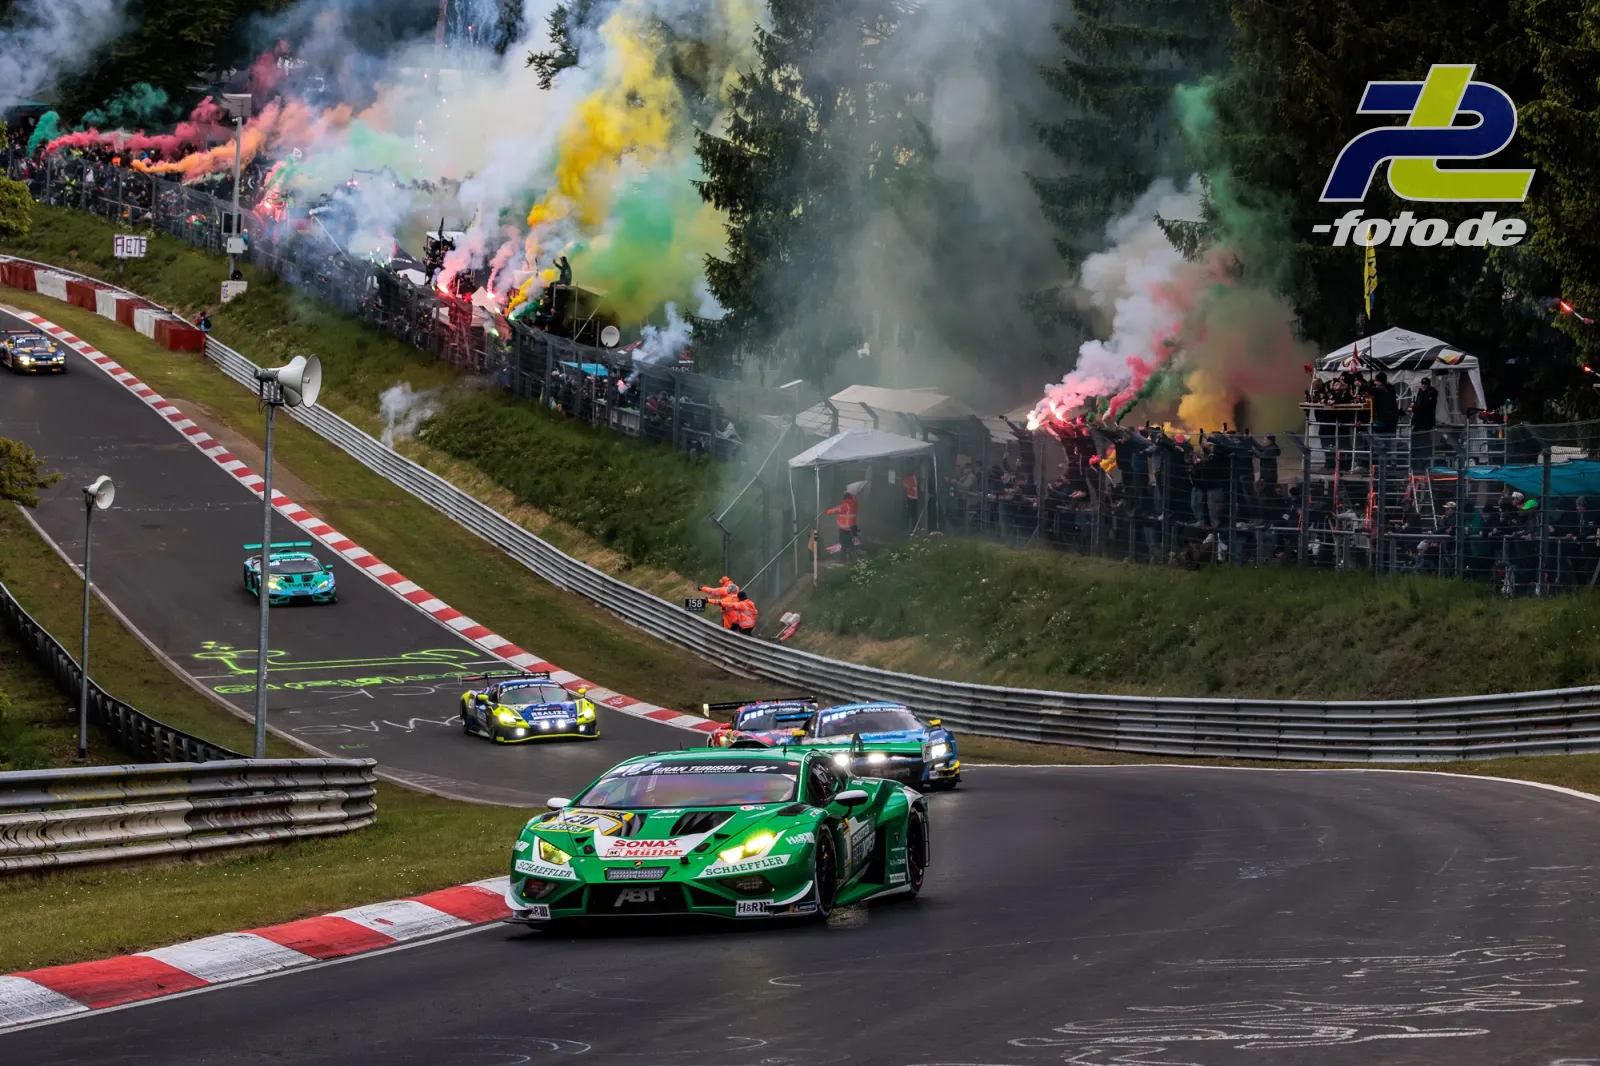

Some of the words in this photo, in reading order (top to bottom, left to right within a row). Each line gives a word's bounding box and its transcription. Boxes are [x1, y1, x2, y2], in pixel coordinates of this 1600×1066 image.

[688, 599, 702, 608] 158
[613, 839, 680, 848] SONAX
[517, 861, 573, 878] SCHAEFFLER
[705, 856, 785, 876] SCHAEFFLER
[614, 888, 660, 907] ABT
[737, 903, 758, 913] H&R
